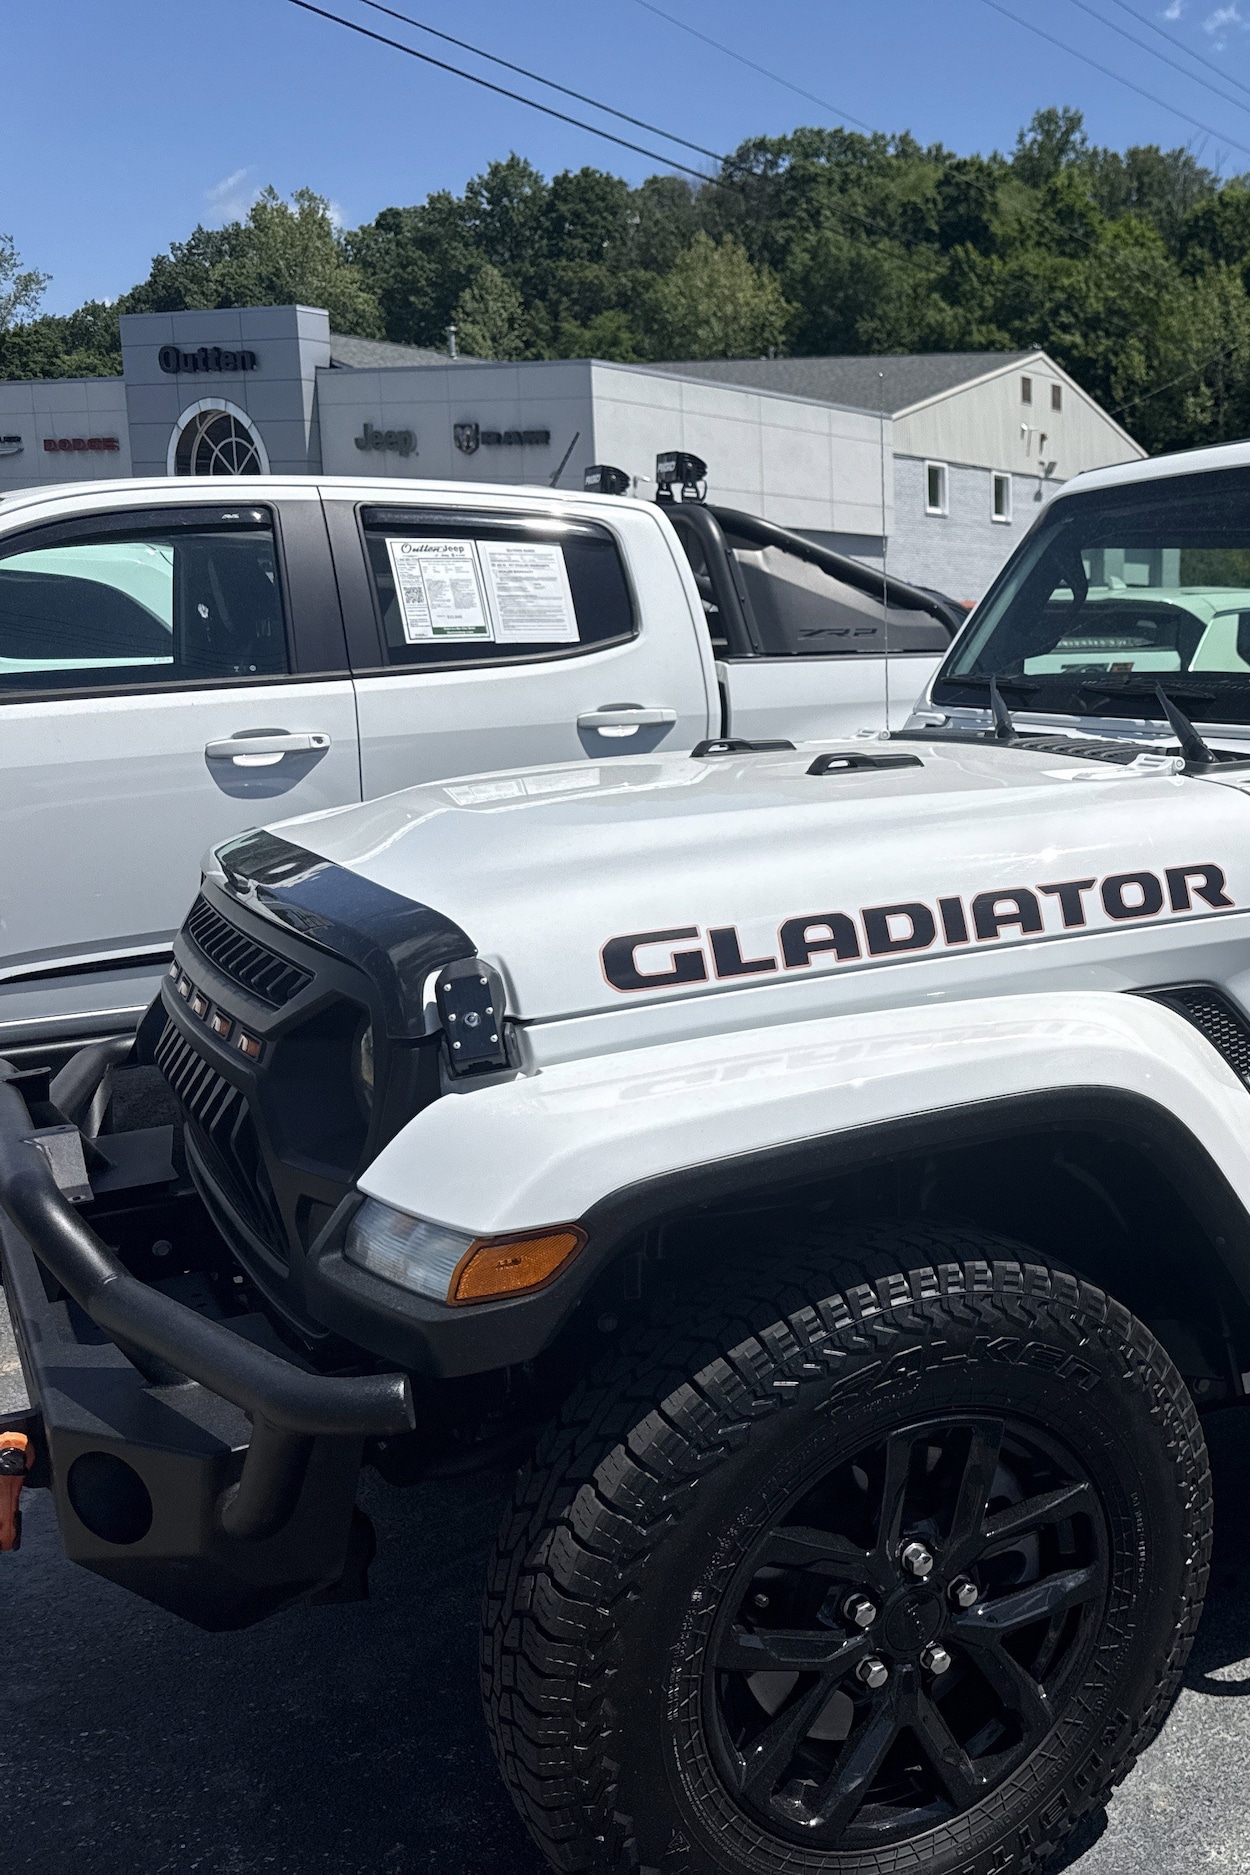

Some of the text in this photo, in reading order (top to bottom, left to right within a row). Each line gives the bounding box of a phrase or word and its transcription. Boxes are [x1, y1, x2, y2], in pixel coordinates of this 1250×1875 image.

[158, 345, 258, 374] Outten
[43, 437, 119, 452] DODGE
[354, 422, 418, 458] Jeep
[598, 861, 1236, 993] GLADIATOR
